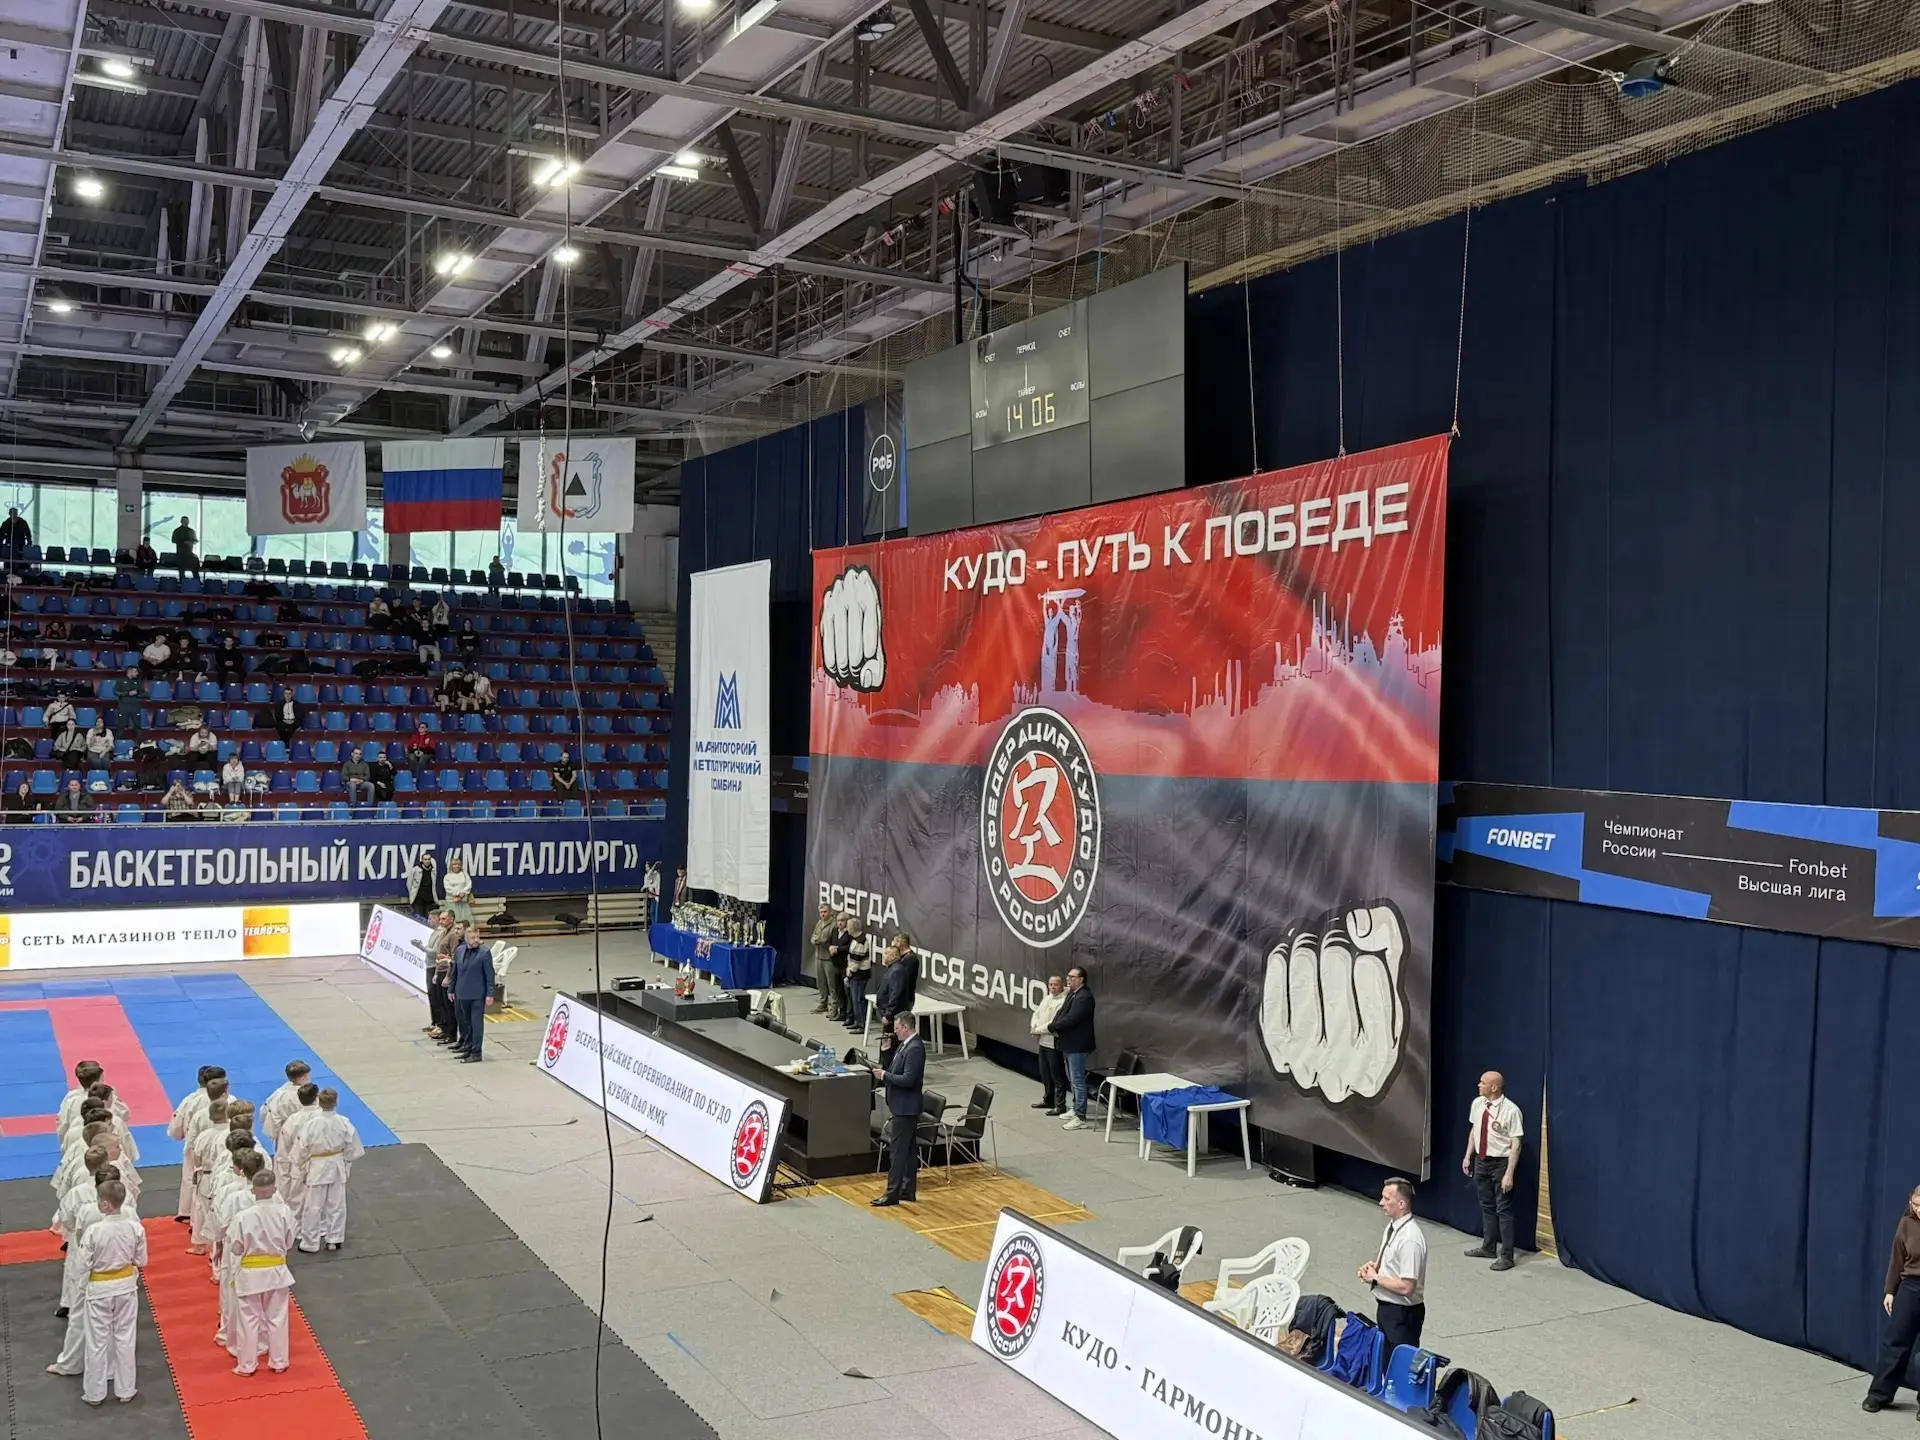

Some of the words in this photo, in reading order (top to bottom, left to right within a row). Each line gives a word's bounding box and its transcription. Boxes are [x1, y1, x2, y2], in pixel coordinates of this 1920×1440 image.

[1016, 341, 1036, 354] ПЕРИОД
[1058, 327, 1071, 338] СЧЕТ
[985, 353, 996, 363] СЧЕТ
[872, 453, 893, 473] РФБ
[944, 548, 1026, 595] КУДО
[1057, 531, 1151, 580] ПУТЬ
[1163, 521, 1191, 567] К
[1204, 482, 1409, 563] ПОБЕДЕ
[987, 721, 1071, 849] ФЕДЕРАЦИЯ
[1070, 755, 1094, 861] КУДО
[1486, 827, 1556, 852] FONBET
[1603, 819, 1684, 841] Чемпионат
[69, 838, 349, 889] БАСКЕТБОЛЬНЫЙ
[358, 843, 438, 881] КЛУБ
[445, 840, 639, 878] «МЕТАЛЛУРГ»
[1602, 839, 1656, 859] России
[1788, 858, 1848, 880] Fonbet
[818, 880, 899, 929] ВСЕГДА
[1737, 874, 1802, 898] Высшая
[1807, 883, 1847, 903] лига
[999, 880, 1077, 934] РОССИИ
[22, 934, 65, 947] СЕТЬ
[72, 931, 176, 946] МАГАЗИНОВ
[182, 928, 238, 941] ТЕПЛО
[606, 1080, 633, 1106] КУБОК
[630, 1094, 648, 1115] ПАО
[646, 1104, 668, 1127] ММК
[632, 1060, 694, 1104] СОРЕВНОВАНИЯ
[692, 1091, 706, 1110] ПО
[706, 1098, 732, 1125] КУДО
[989, 1239, 1040, 1298] ФЕДЕРАЦИЯ
[1031, 1266, 1043, 1323] КУДО
[989, 1317, 1025, 1353] РОССИИ
[1060, 1319, 1118, 1370] КУДО
